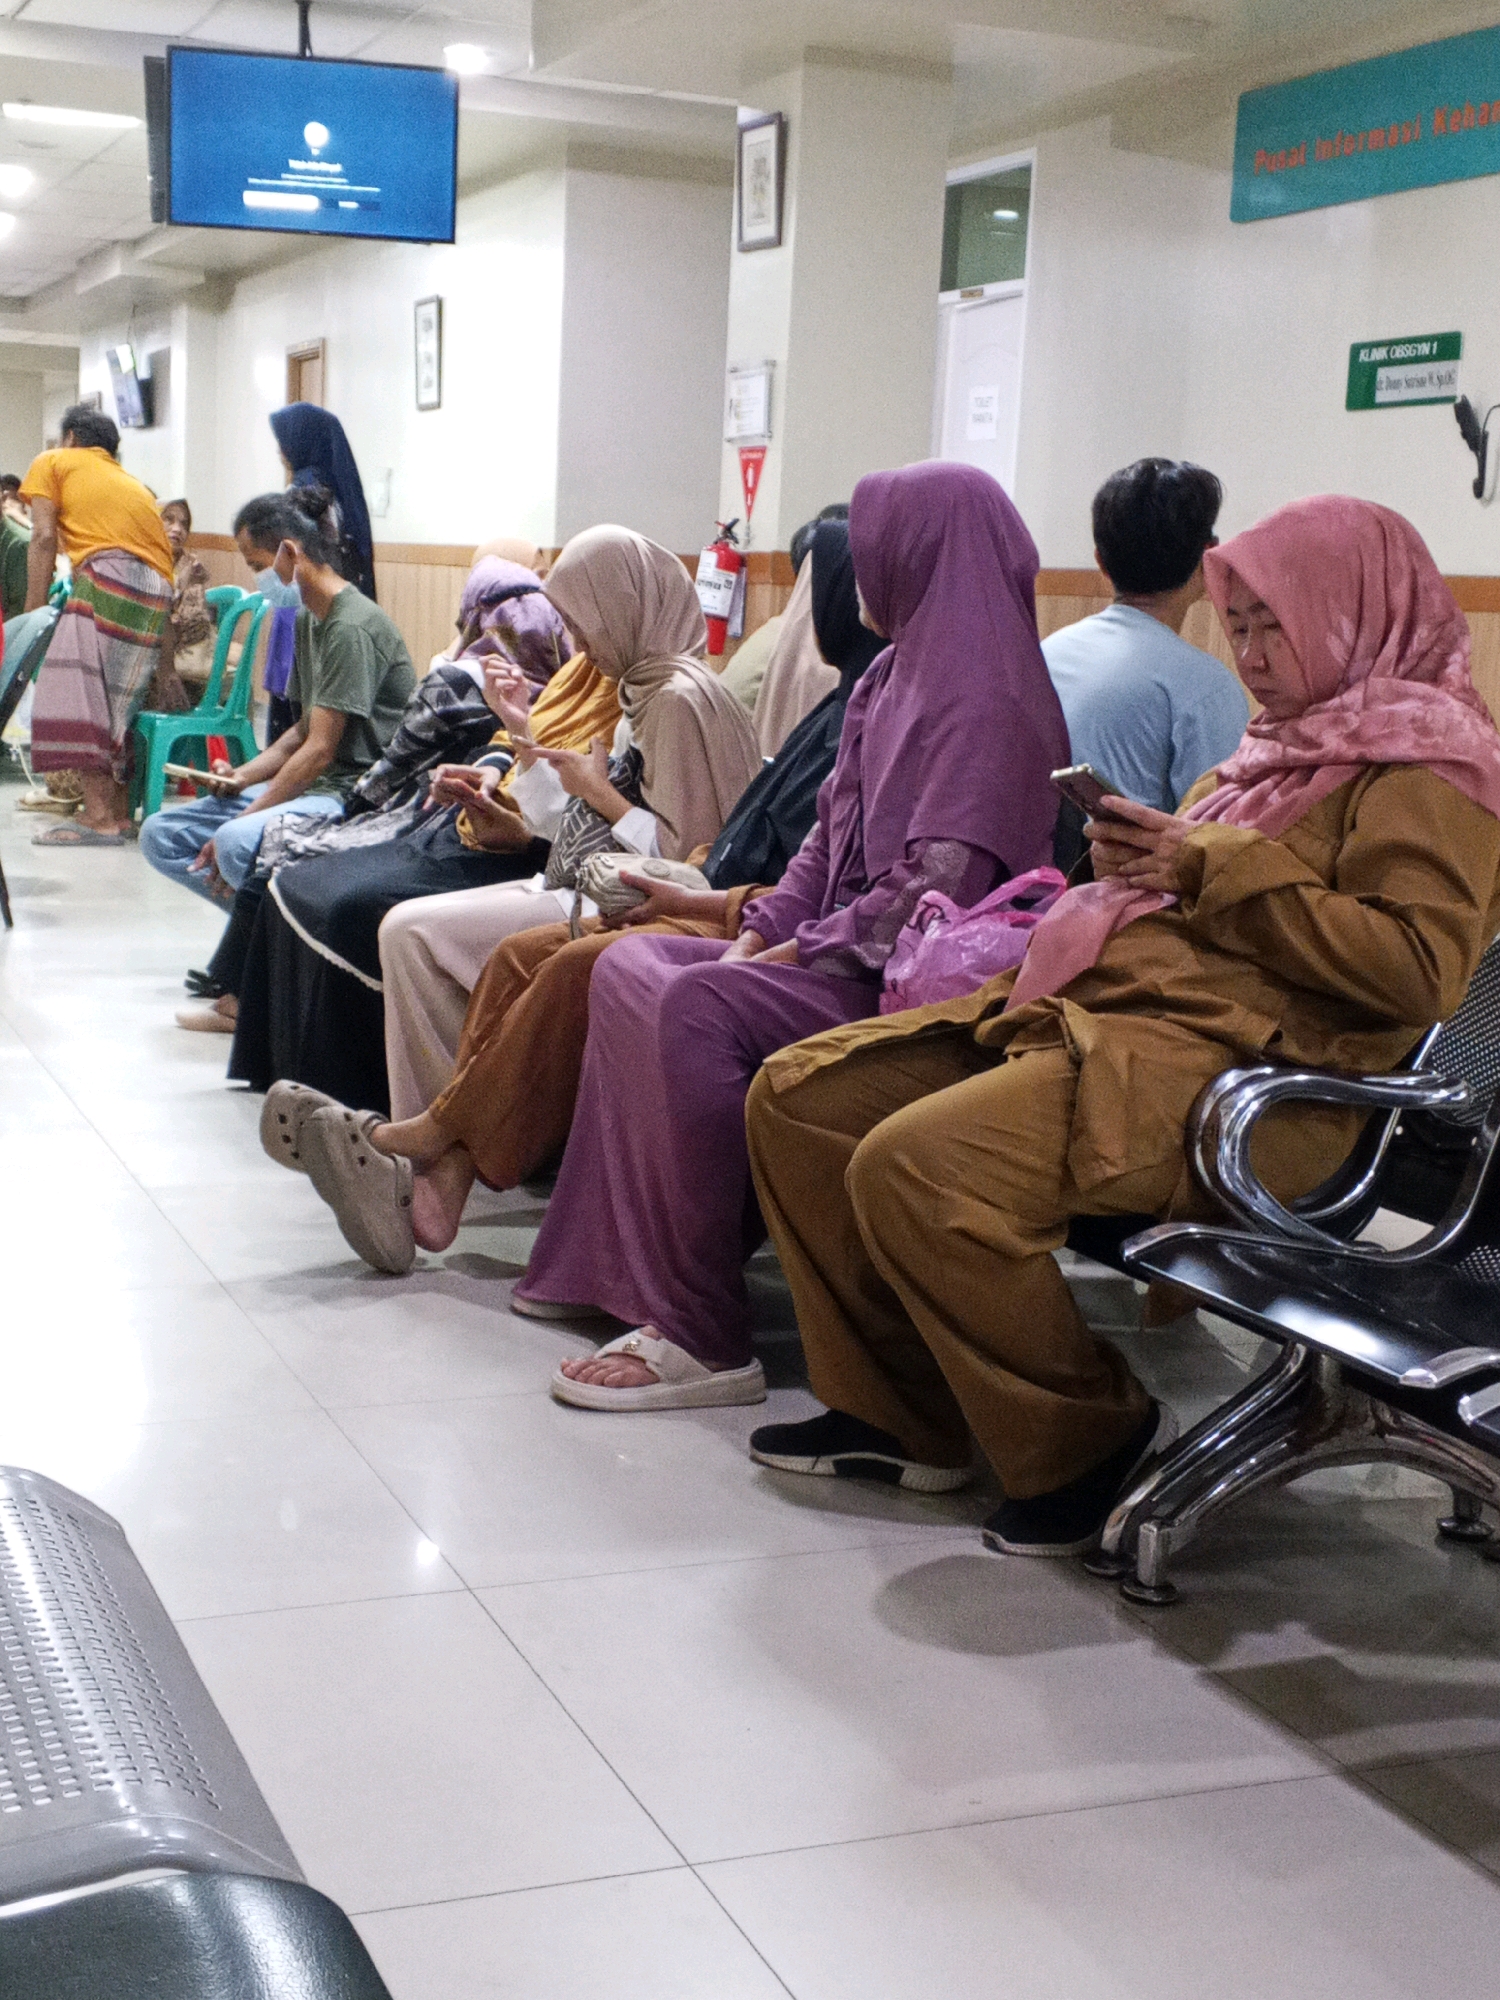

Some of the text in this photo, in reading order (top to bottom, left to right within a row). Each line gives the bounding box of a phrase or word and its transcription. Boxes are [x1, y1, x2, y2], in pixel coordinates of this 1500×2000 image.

[1254, 142, 1308, 176] Pusat
[1315, 113, 1422, 162] Informasi
[1359, 341, 1438, 362] KLINIK OBSGYN 1
